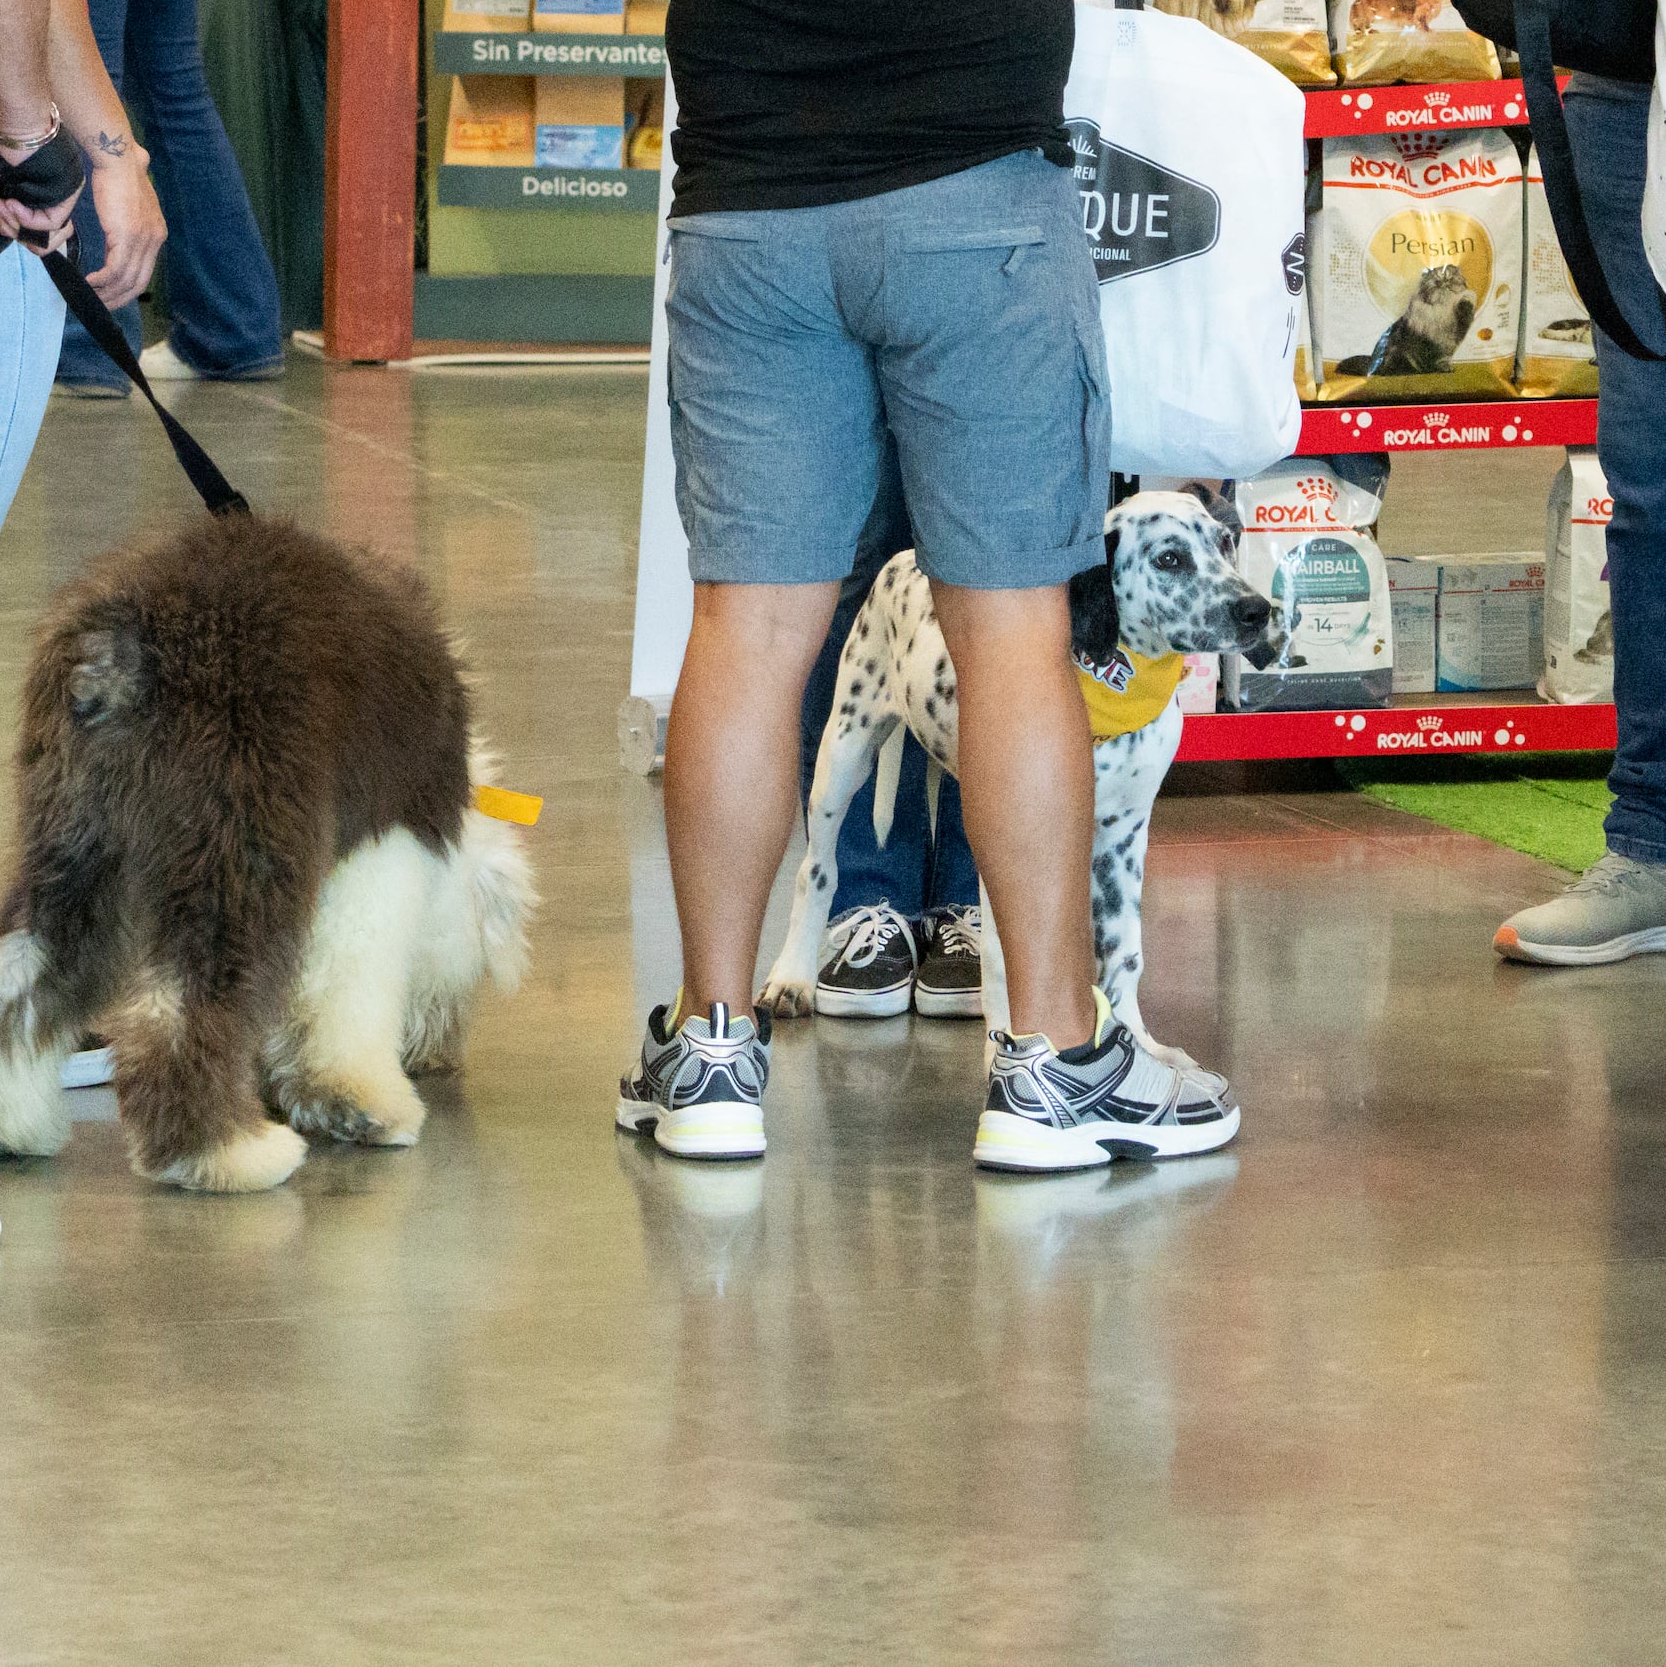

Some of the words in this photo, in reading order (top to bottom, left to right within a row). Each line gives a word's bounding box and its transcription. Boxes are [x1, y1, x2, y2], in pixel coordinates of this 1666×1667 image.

[472, 39, 510, 62] Sin
[1385, 108, 1436, 127] ROYAL
[1438, 104, 1493, 124] CANIN
[1350, 156, 1419, 188] ROYAL
[522, 176, 628, 199] Delicioso
[1391, 232, 1475, 258] Persian
[1383, 429, 1435, 446] ROYAL
[1436, 426, 1490, 444] CANIN
[1255, 505, 1318, 523] ROYAL
[1311, 543, 1337, 552] CARE
[1314, 617, 1333, 633] 14
[1376, 733, 1428, 750] ROYAL
[1430, 730, 1483, 748] CANIN
